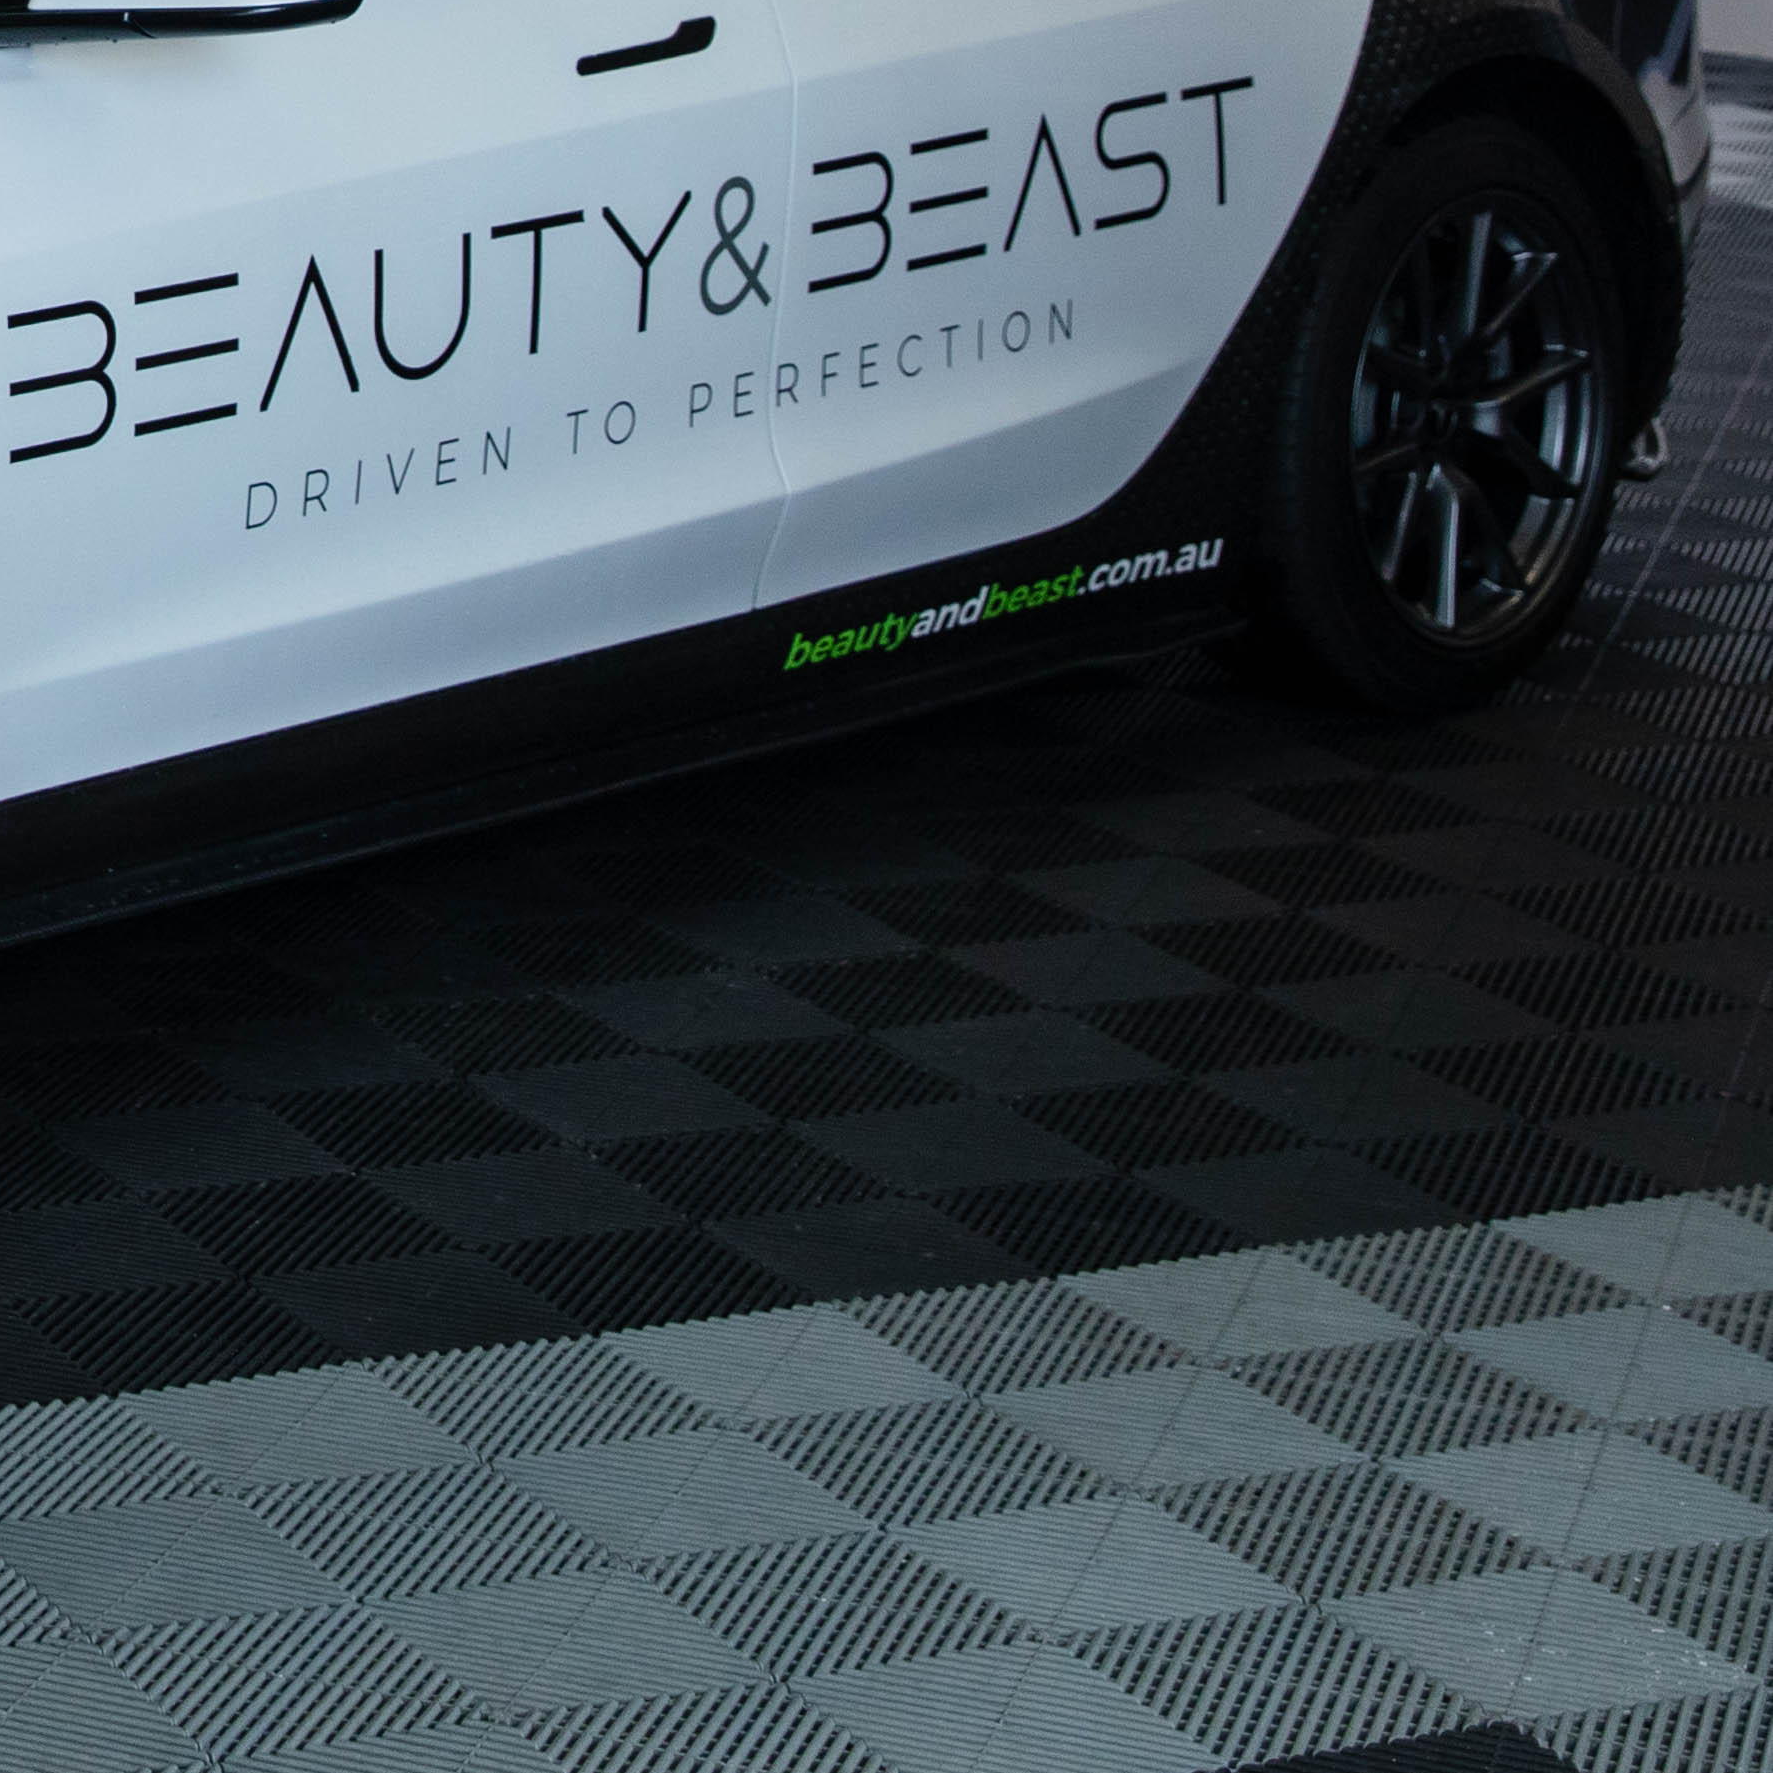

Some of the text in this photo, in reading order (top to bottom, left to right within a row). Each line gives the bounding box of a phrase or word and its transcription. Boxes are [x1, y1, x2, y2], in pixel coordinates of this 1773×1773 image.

[6, 189, 693, 465] BEAUTY
[806, 74, 1256, 295] BEAST
[244, 298, 1074, 531] DRIVEN TO PERFECTION
[783, 538, 1223, 671] beautyandbeast.com.au
